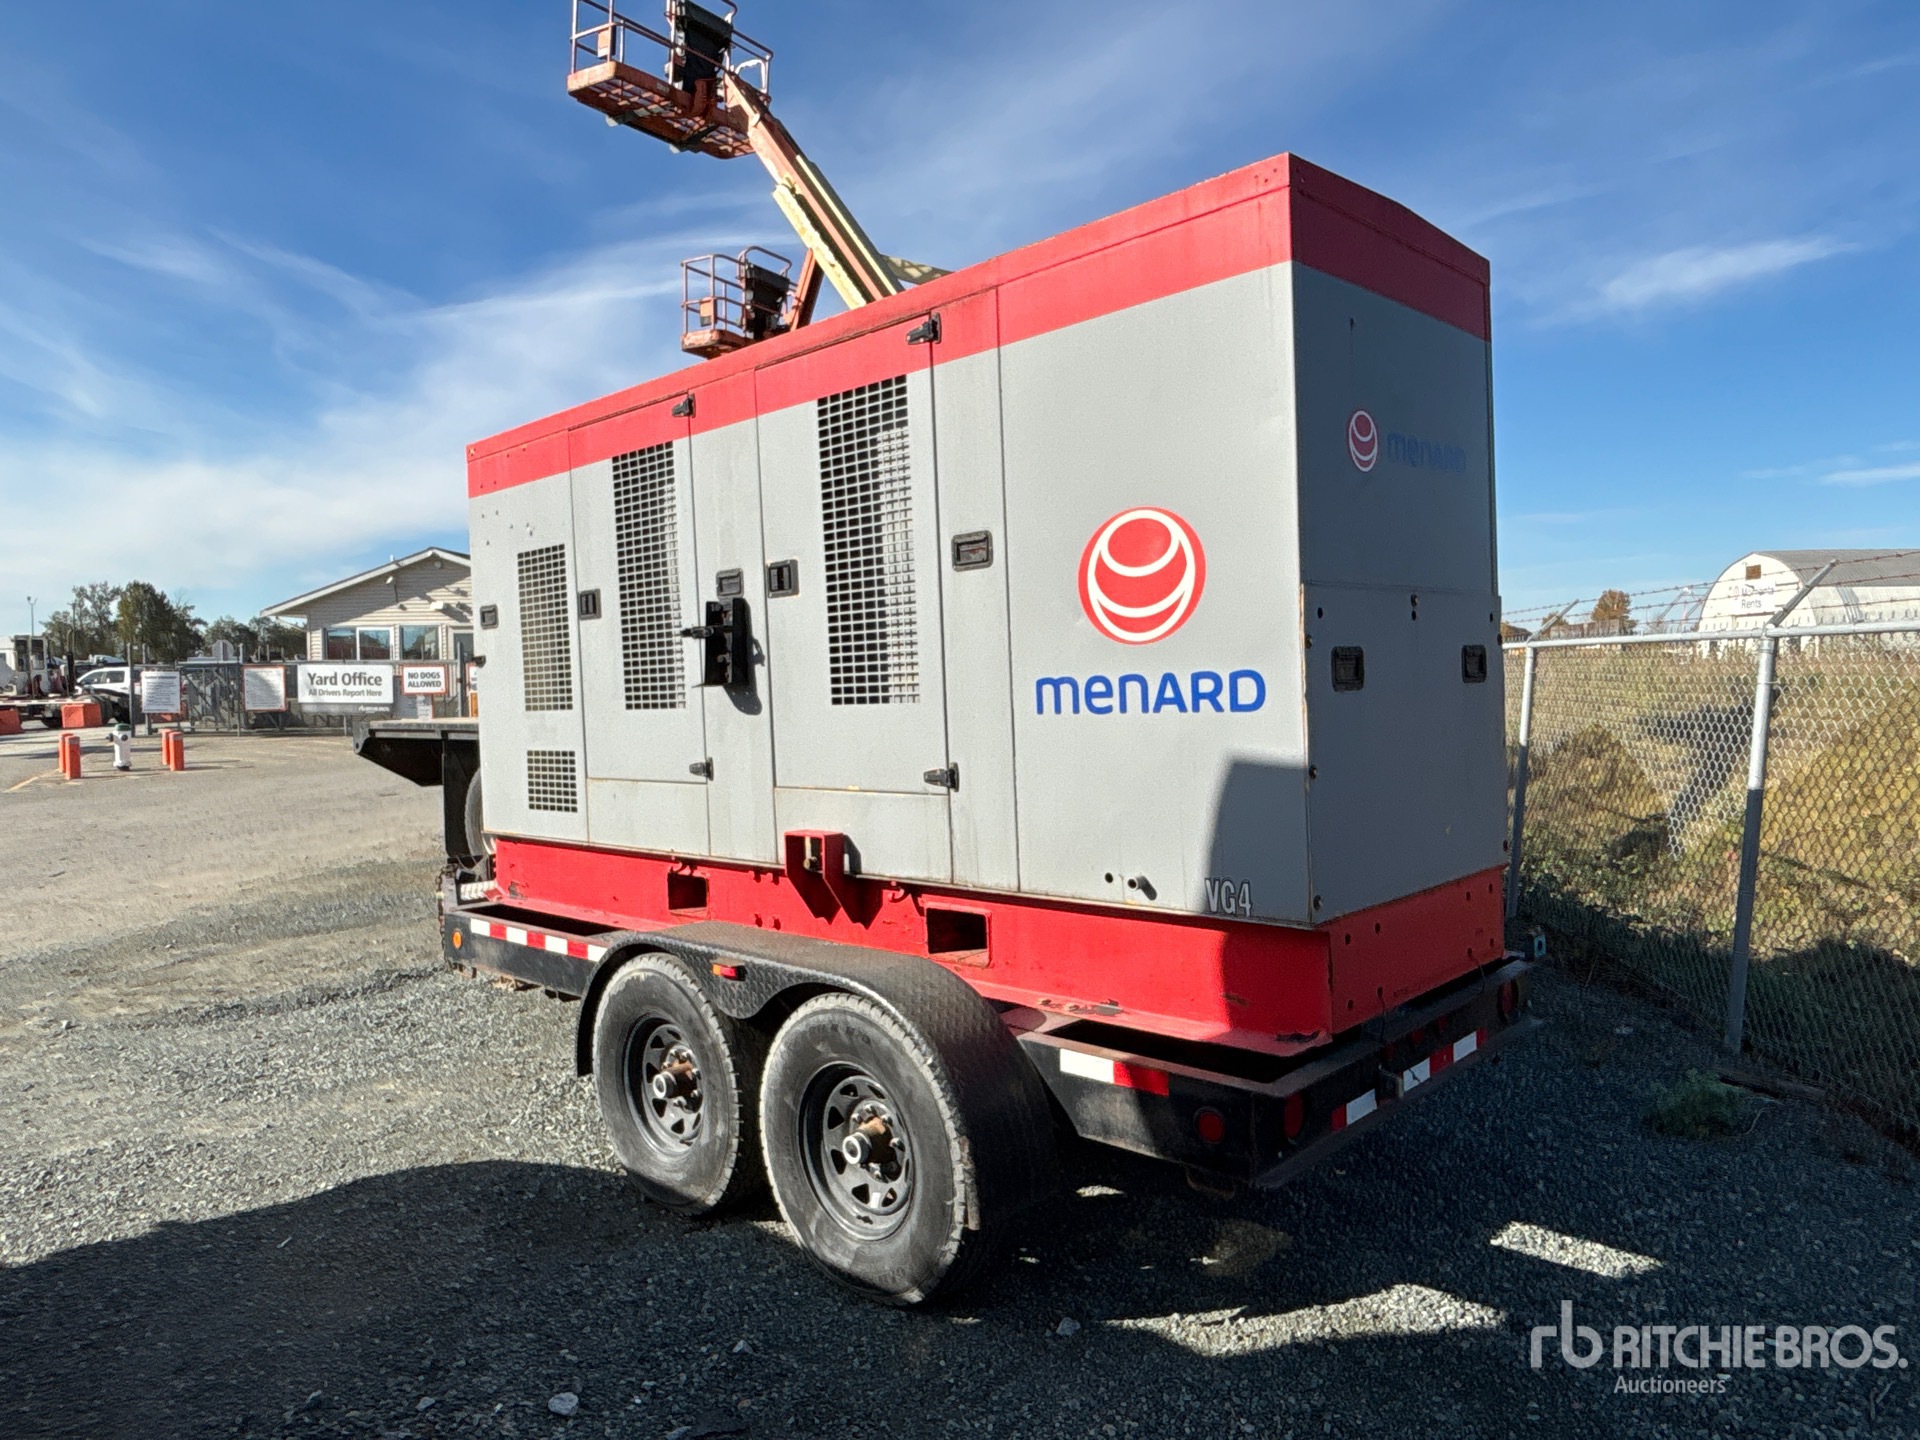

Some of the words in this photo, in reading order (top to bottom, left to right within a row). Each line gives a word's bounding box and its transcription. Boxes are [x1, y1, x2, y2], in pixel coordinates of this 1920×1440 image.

[1741, 599, 1762, 609] Rents
[307, 671, 338, 686] Yard
[341, 671, 382, 686] Office
[407, 671, 419, 679] NO
[420, 671, 441, 679] DOGS
[407, 680, 442, 688] ALLOWED
[308, 688, 317, 697] All
[318, 688, 341, 697] Drivers
[343, 689, 365, 698] Report
[366, 689, 382, 697] Here
[1204, 878, 1252, 918] VG4
